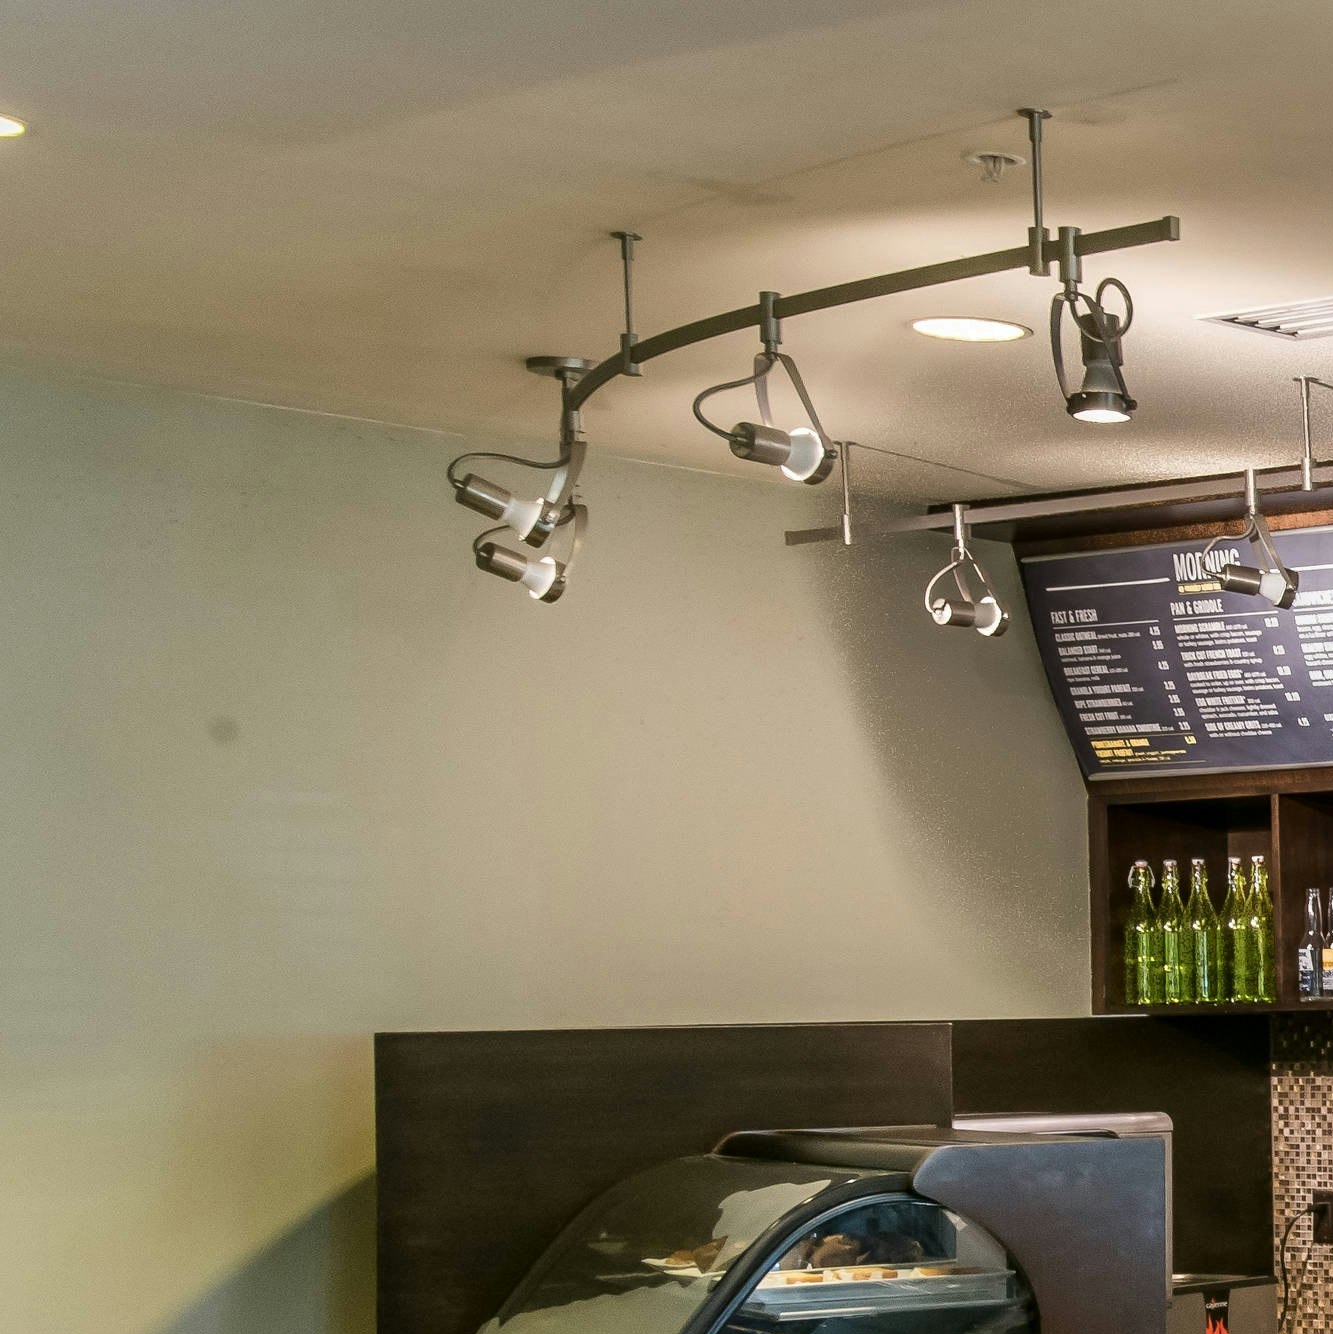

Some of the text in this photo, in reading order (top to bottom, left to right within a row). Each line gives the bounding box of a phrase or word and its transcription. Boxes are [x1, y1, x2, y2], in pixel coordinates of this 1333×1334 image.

[1170, 599, 1224, 615] PAN & GRIDDLE
[1050, 609, 1098, 624] FAST & FRESH
